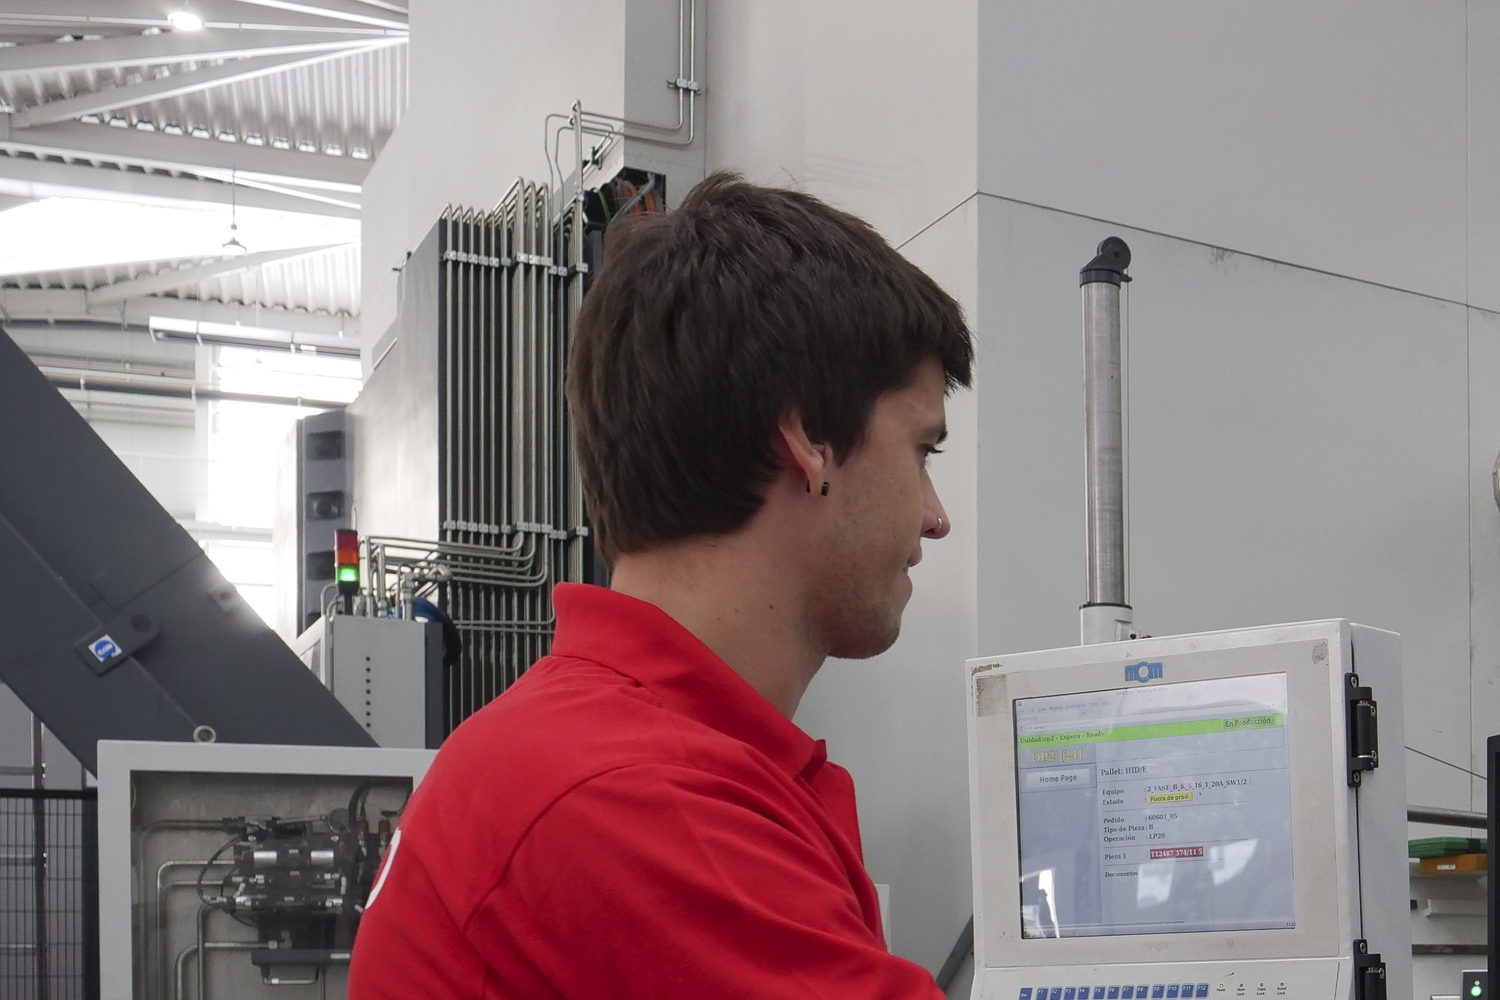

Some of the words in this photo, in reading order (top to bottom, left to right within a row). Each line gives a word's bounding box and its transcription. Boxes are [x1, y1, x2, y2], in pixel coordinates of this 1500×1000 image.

[1224, 720, 1234, 728] En
[1234, 716, 1272, 727] Producción
[1039, 774, 1057, 784] Home
[1058, 774, 1077, 784] Page
[1103, 834, 1136, 843] Operación
